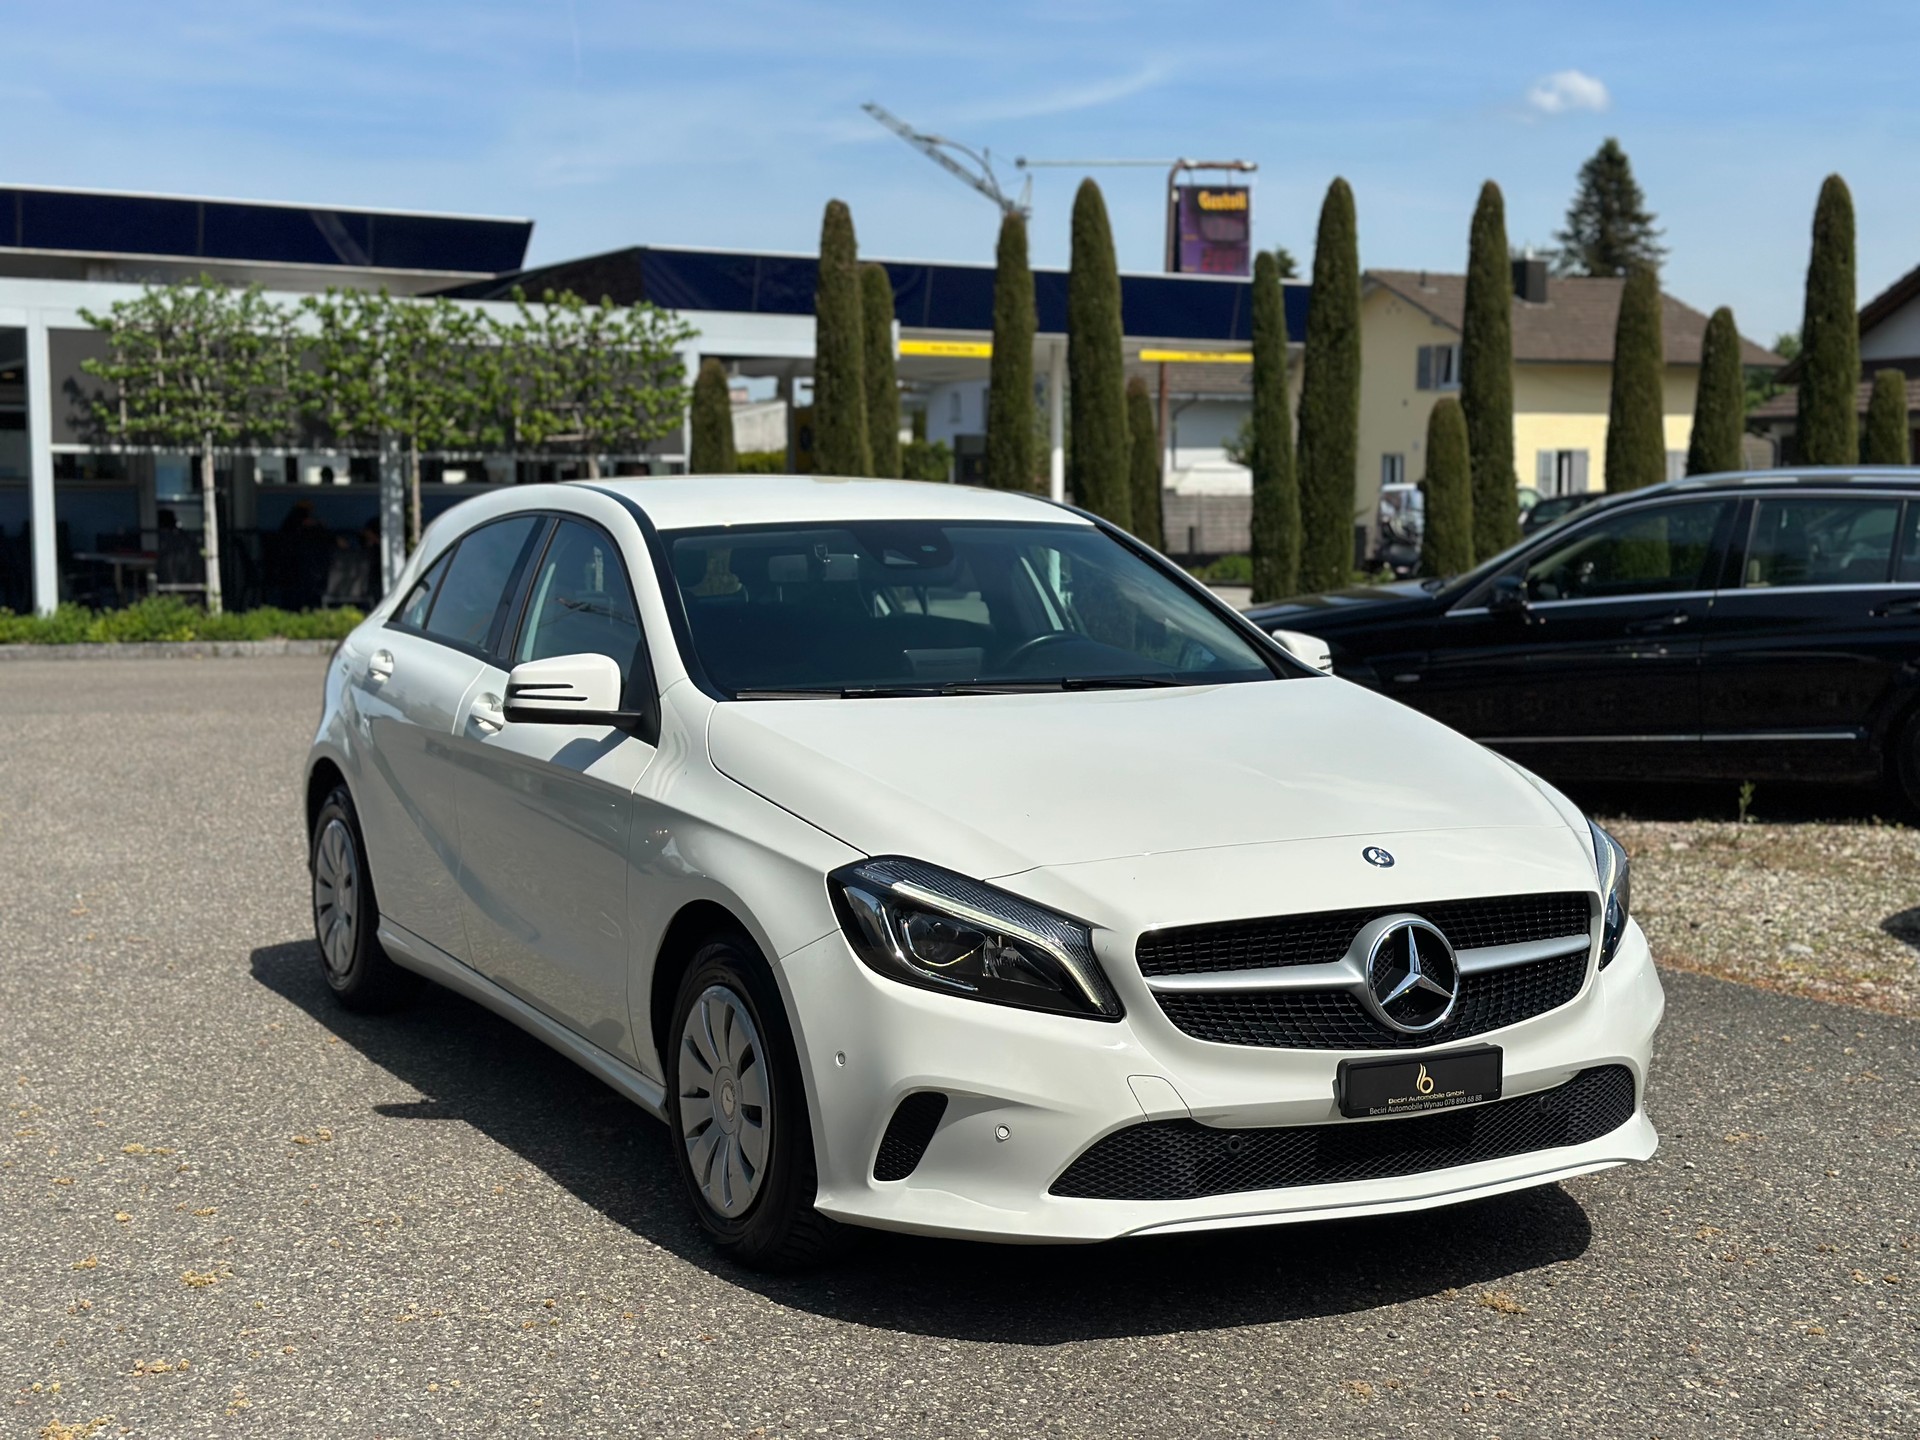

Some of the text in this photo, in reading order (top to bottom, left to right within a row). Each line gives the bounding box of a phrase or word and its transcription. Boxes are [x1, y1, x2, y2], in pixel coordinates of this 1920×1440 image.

[1408, 1092, 1445, 1102] Automobile
[1369, 1107, 1387, 1115] Beciri
[1387, 1102, 1423, 1113] Automobile
[1423, 1101, 1444, 1110] Wynau
